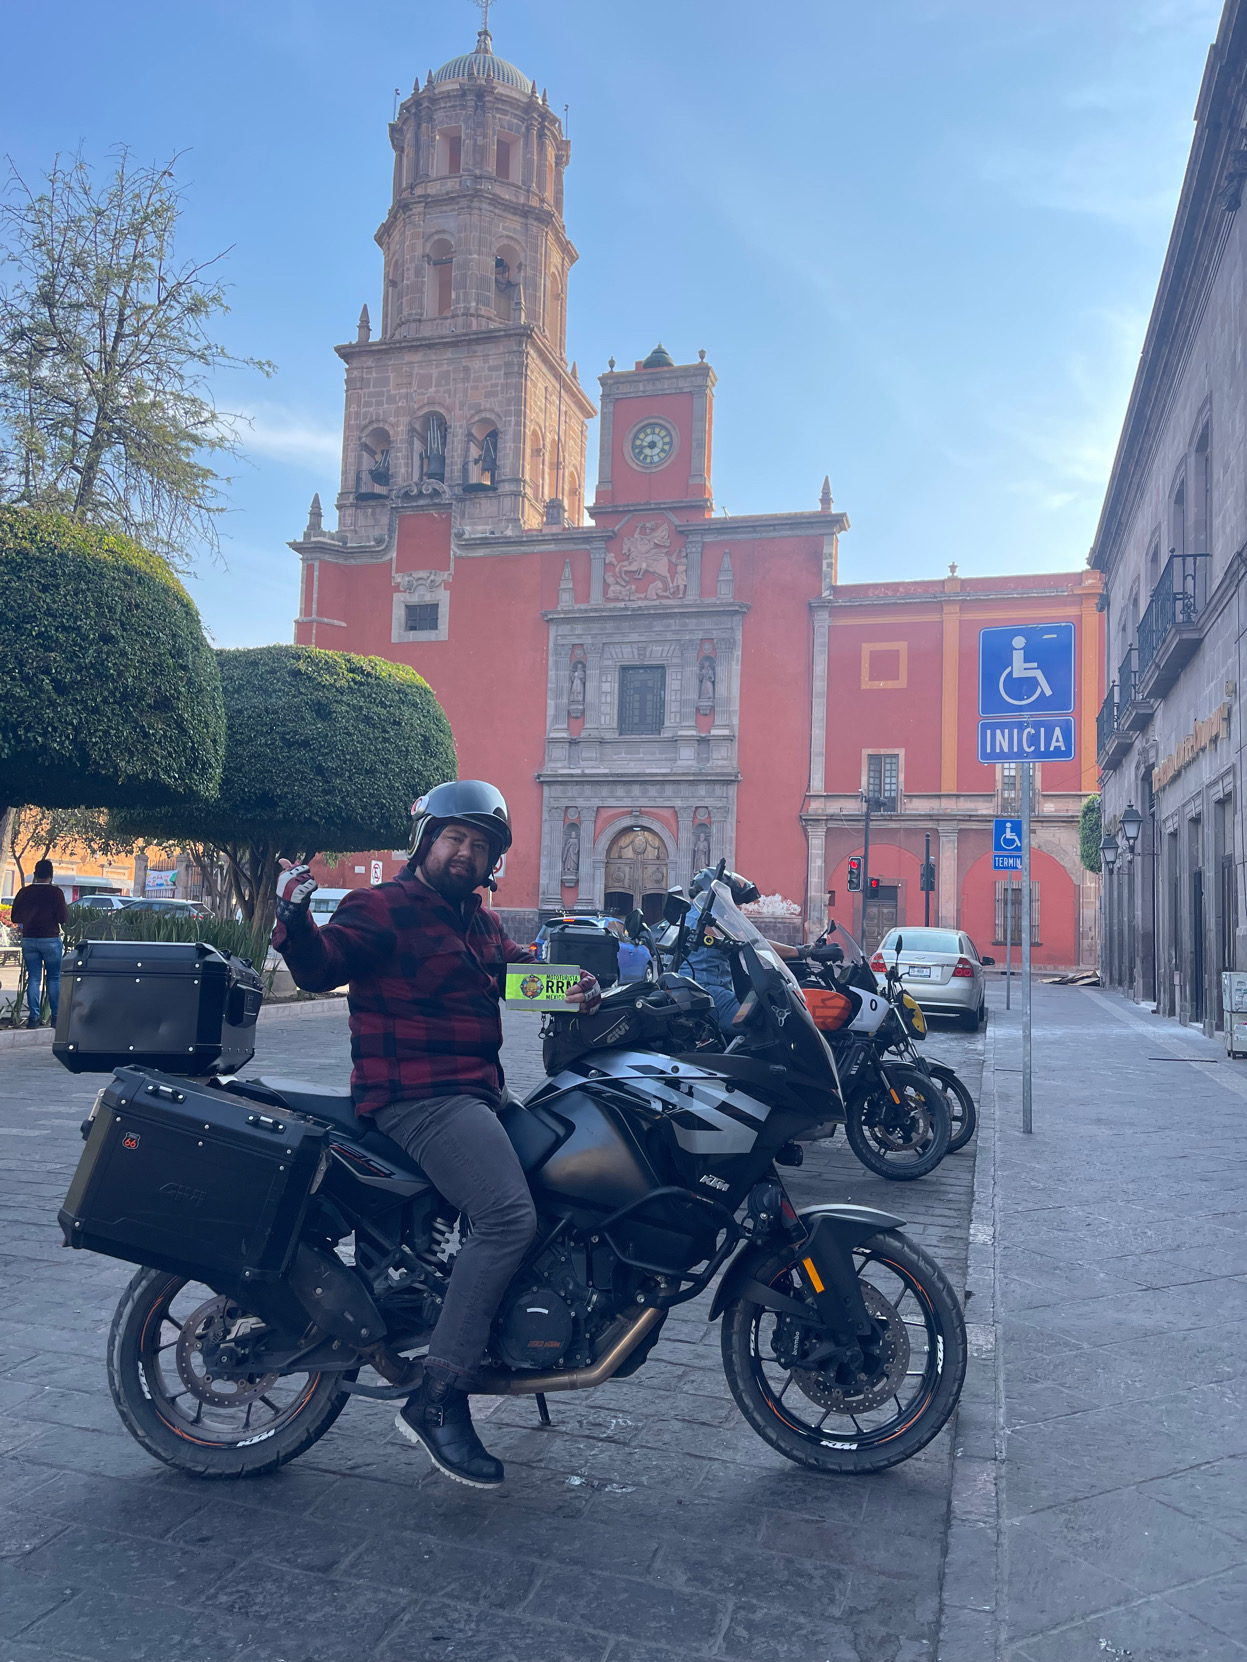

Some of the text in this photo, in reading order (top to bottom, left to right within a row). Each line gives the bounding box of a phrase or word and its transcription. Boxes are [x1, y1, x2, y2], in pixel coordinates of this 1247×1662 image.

[986, 727, 1066, 753] INICIA
[995, 857, 1022, 867] TERMIN
[606, 1021, 630, 1044] GIVI
[124, 1138, 137, 1148] 66
[699, 1174, 731, 1192] KTM
[791, 1331, 800, 1356] brembo
[236, 1428, 276, 1447] KTM
[820, 1440, 858, 1450] KTM
